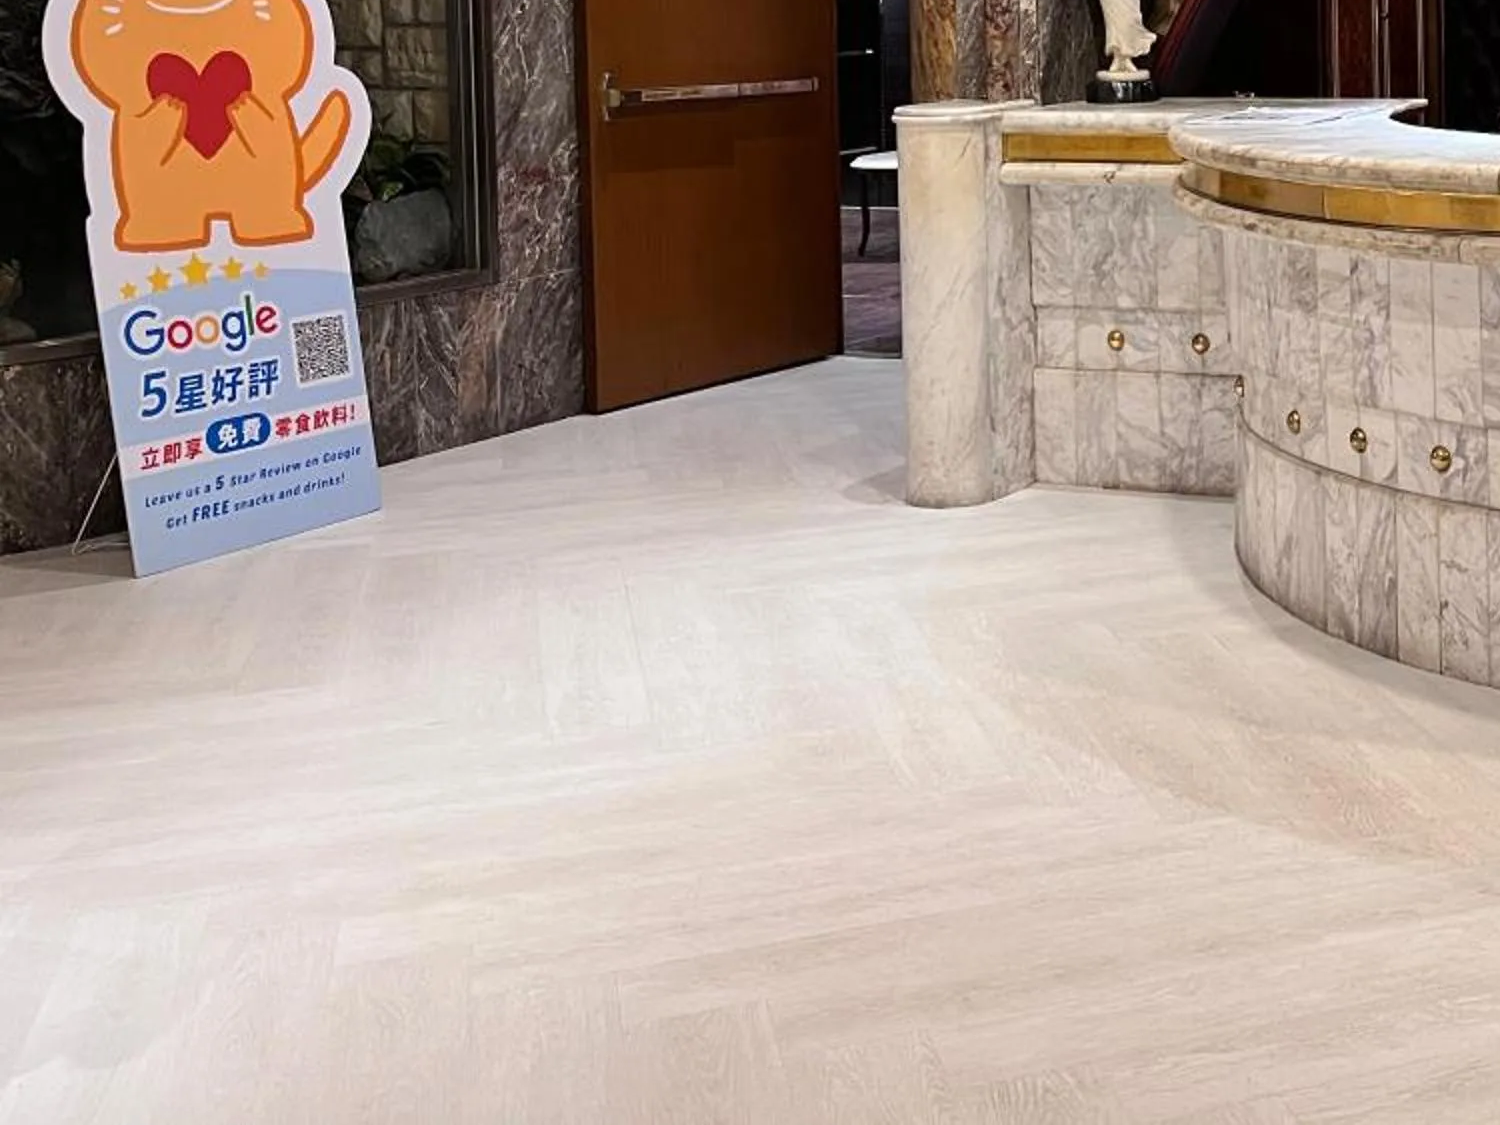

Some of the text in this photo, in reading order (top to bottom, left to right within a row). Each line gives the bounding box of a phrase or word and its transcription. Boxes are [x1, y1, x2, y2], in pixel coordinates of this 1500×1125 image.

[123, 295, 279, 355] Google
[140, 359, 279, 418] 5星好評
[139, 438, 204, 470] 立即享
[217, 421, 263, 451] 免費
[145, 445, 361, 508] Leave us a 5 Star Review on Google
[166, 472, 345, 529] Get FREE snacks and drinks!
